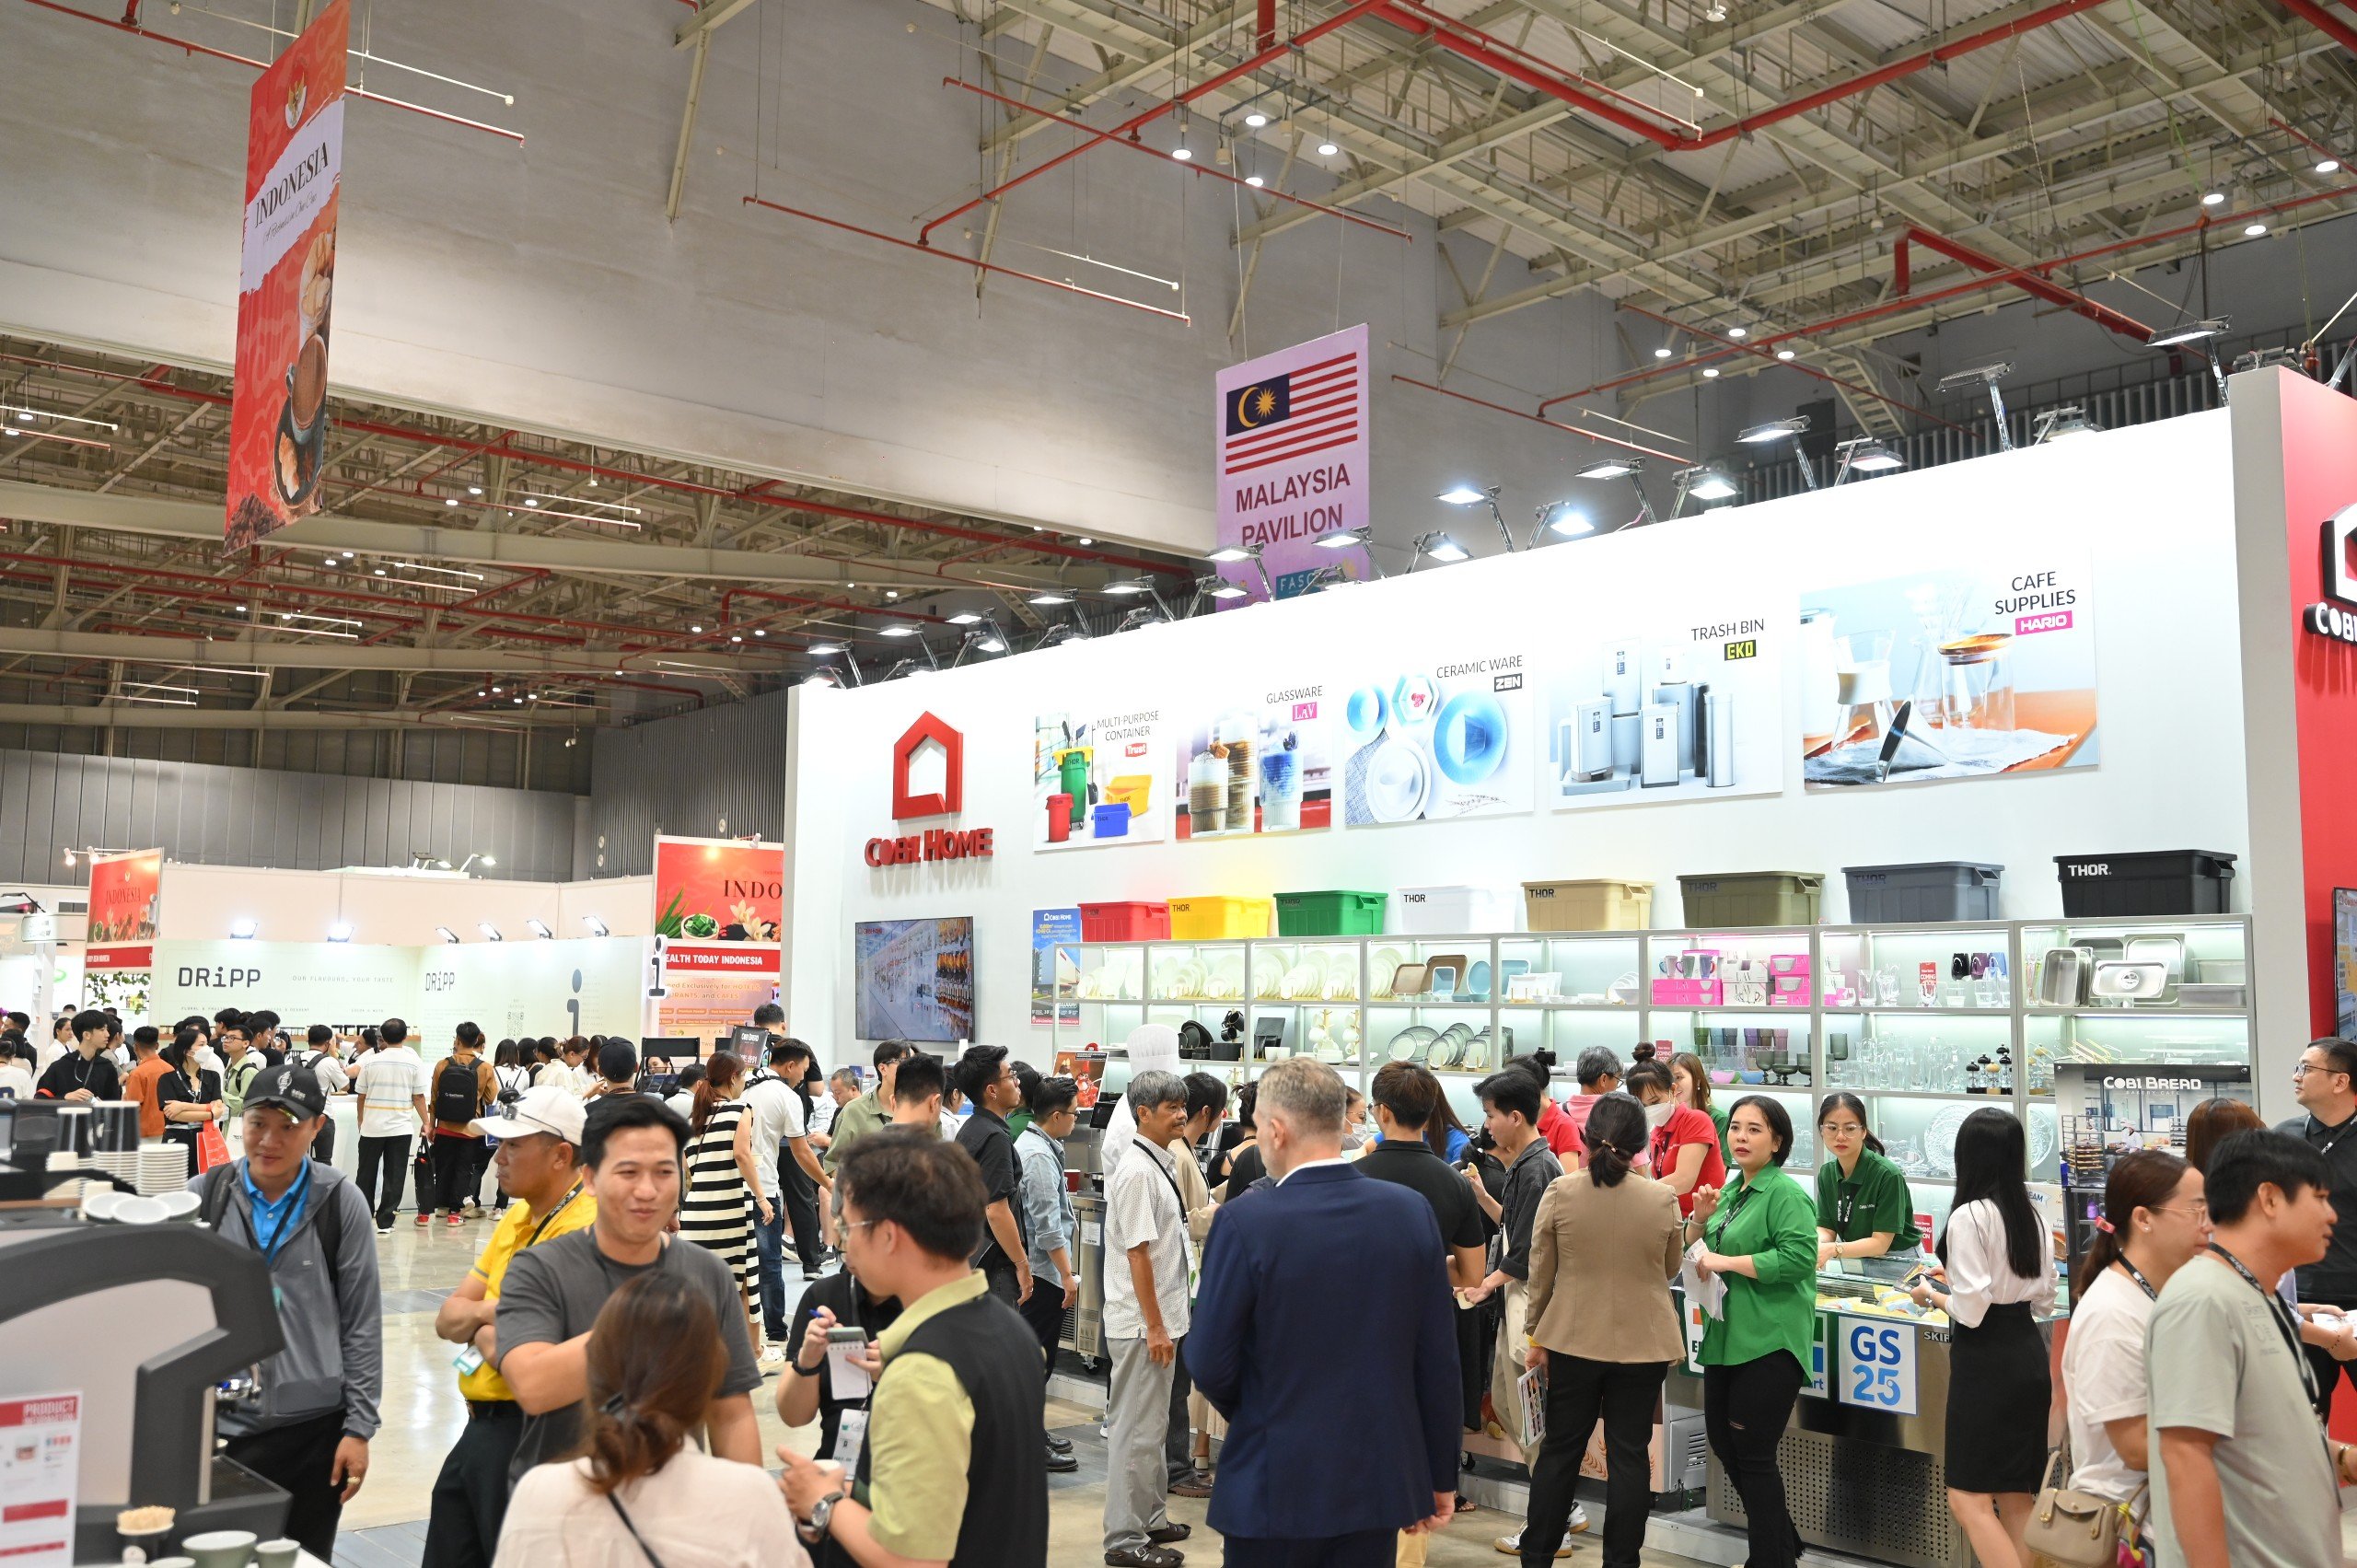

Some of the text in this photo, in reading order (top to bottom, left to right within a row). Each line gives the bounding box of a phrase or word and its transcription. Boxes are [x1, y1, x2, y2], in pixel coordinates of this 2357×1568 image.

[255, 142, 328, 228] INDONESIA
[1237, 463, 1351, 513] MALAYSIA
[1243, 504, 1342, 546] PAVILION
[2012, 571, 2057, 591] CAFE
[1995, 589, 2076, 615] SUPPLIES
[1691, 619, 1765, 641] TRASH BIN
[2020, 614, 2068, 633] HARIO
[1727, 641, 1754, 659] EKO
[1436, 655, 1523, 679] CERAMIC WARE
[1495, 676, 1521, 690] ZEN
[1266, 686, 1322, 704] GLASSWARE
[1097, 711, 1159, 728] MULTI-PURPOSE
[1105, 726, 1150, 741] CONTAINER
[1127, 744, 1146, 755] Trust
[923, 828, 993, 861] HOME
[2068, 864, 2109, 877] THOR
[106, 887, 141, 904] INDONESIA
[1529, 889, 1555, 899] THOR
[1688, 882, 1717, 892] THOR
[1404, 894, 1426, 903] THOR
[1172, 904, 1190, 912] THOR
[666, 954, 763, 965] EALTH TODAY INDONESIA
[2146, 1077, 2201, 1090] BREAD
[2027, 1191, 2043, 1202] EAM
[1850, 1326, 1901, 1365] GS
[1852, 1364, 1902, 1406] 25
